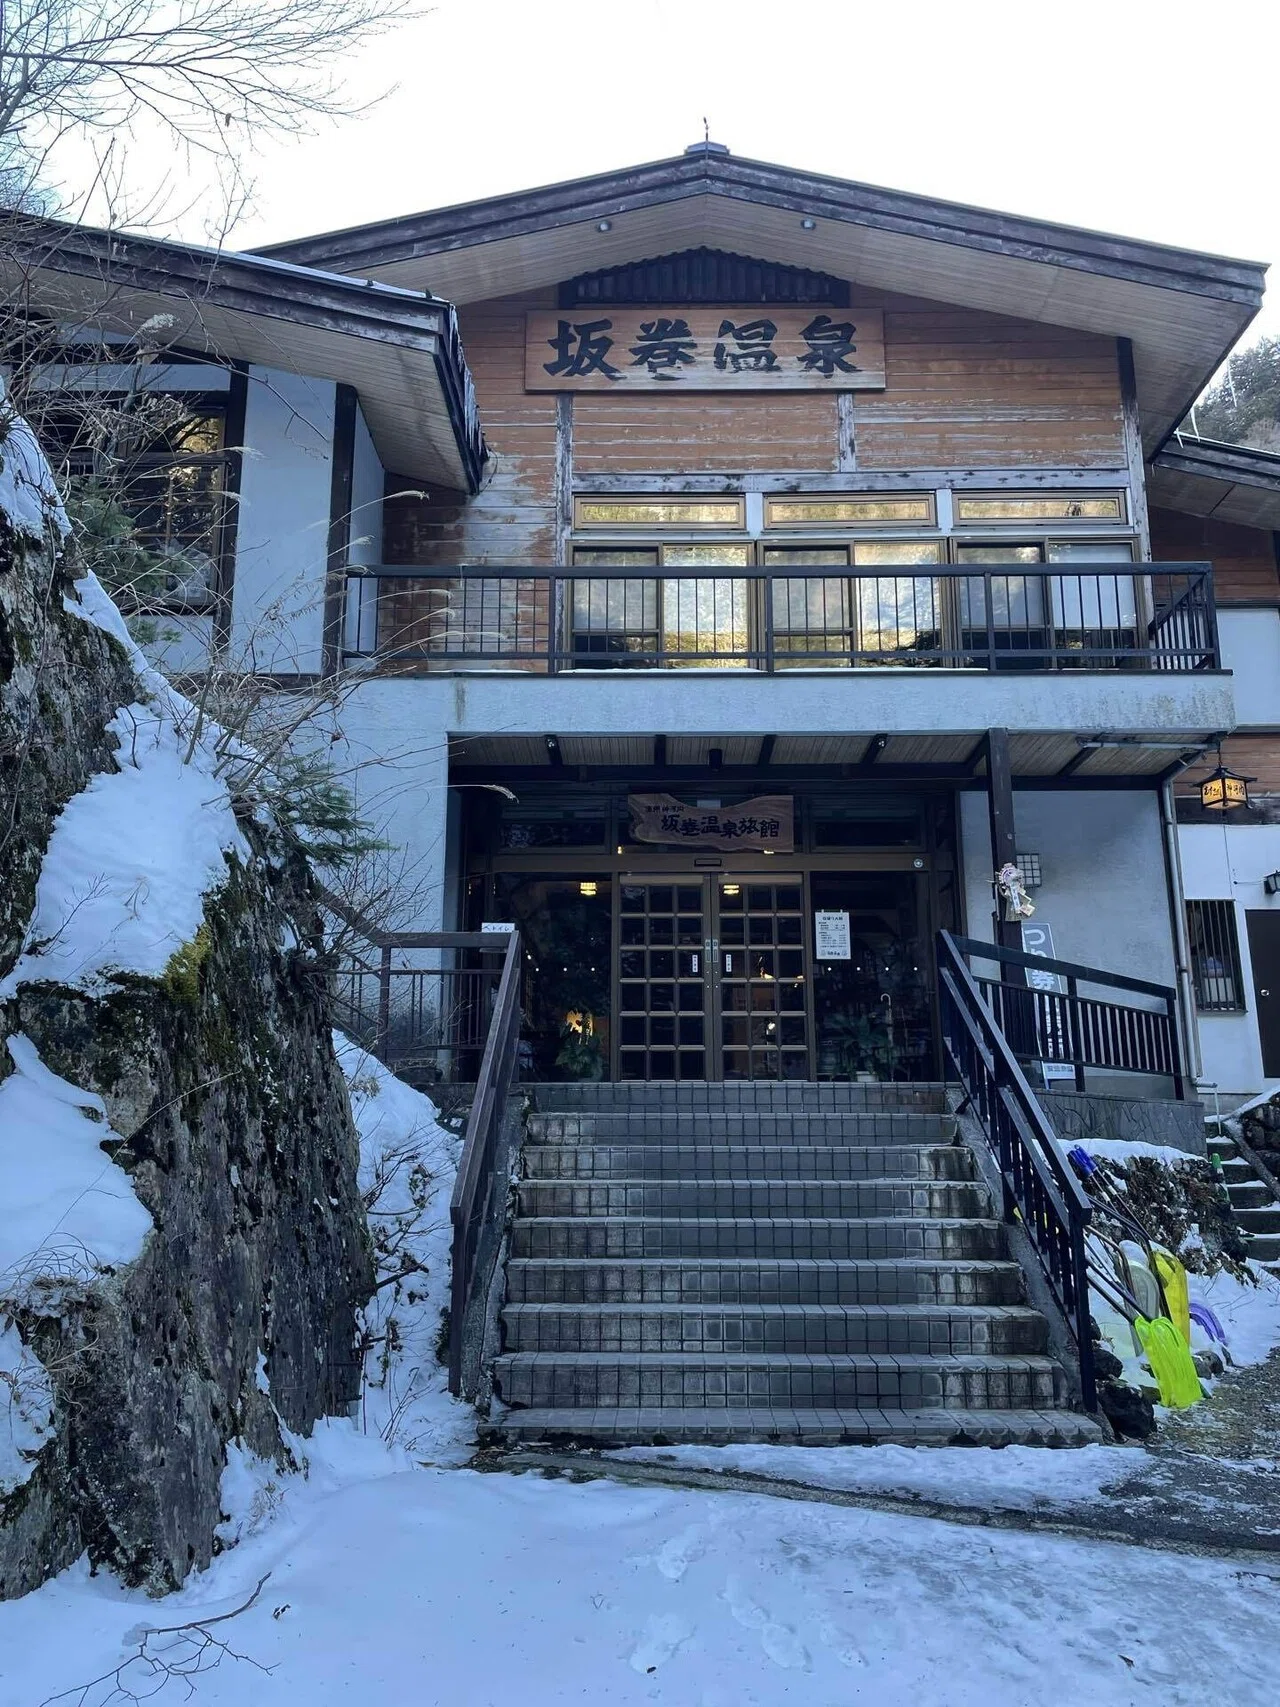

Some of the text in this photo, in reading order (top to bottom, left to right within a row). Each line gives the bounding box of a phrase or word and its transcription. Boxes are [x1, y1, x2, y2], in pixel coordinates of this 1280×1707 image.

[542, 315, 862, 379] 坂巻温泉
[661, 814, 780, 839] 坂巻温泉旅館
